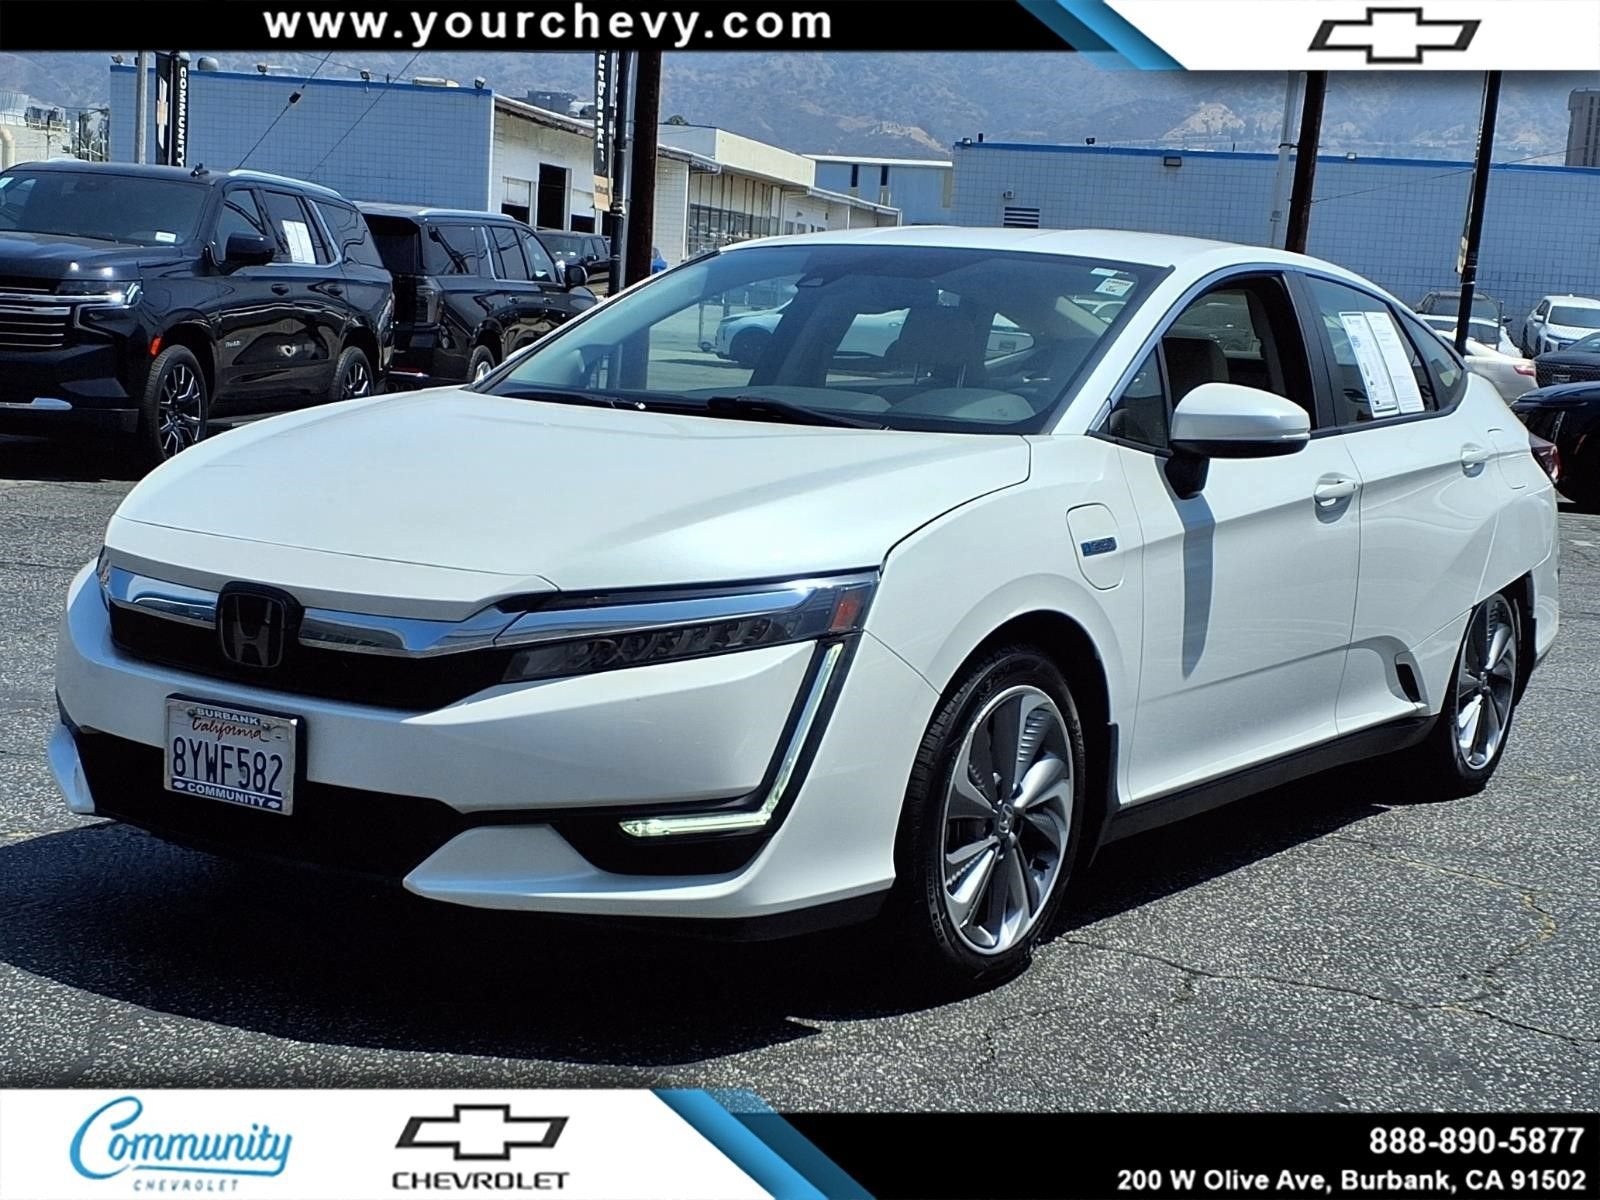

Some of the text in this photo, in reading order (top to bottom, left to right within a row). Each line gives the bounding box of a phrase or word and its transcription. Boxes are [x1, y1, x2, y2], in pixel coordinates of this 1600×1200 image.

[177, 66, 187, 167] COMMUNITY
[191, 716, 270, 742] California
[196, 706, 260, 726] BURBANK
[173, 736, 283, 797] 8YWF582
[186, 782, 266, 809] COMMUNITY
